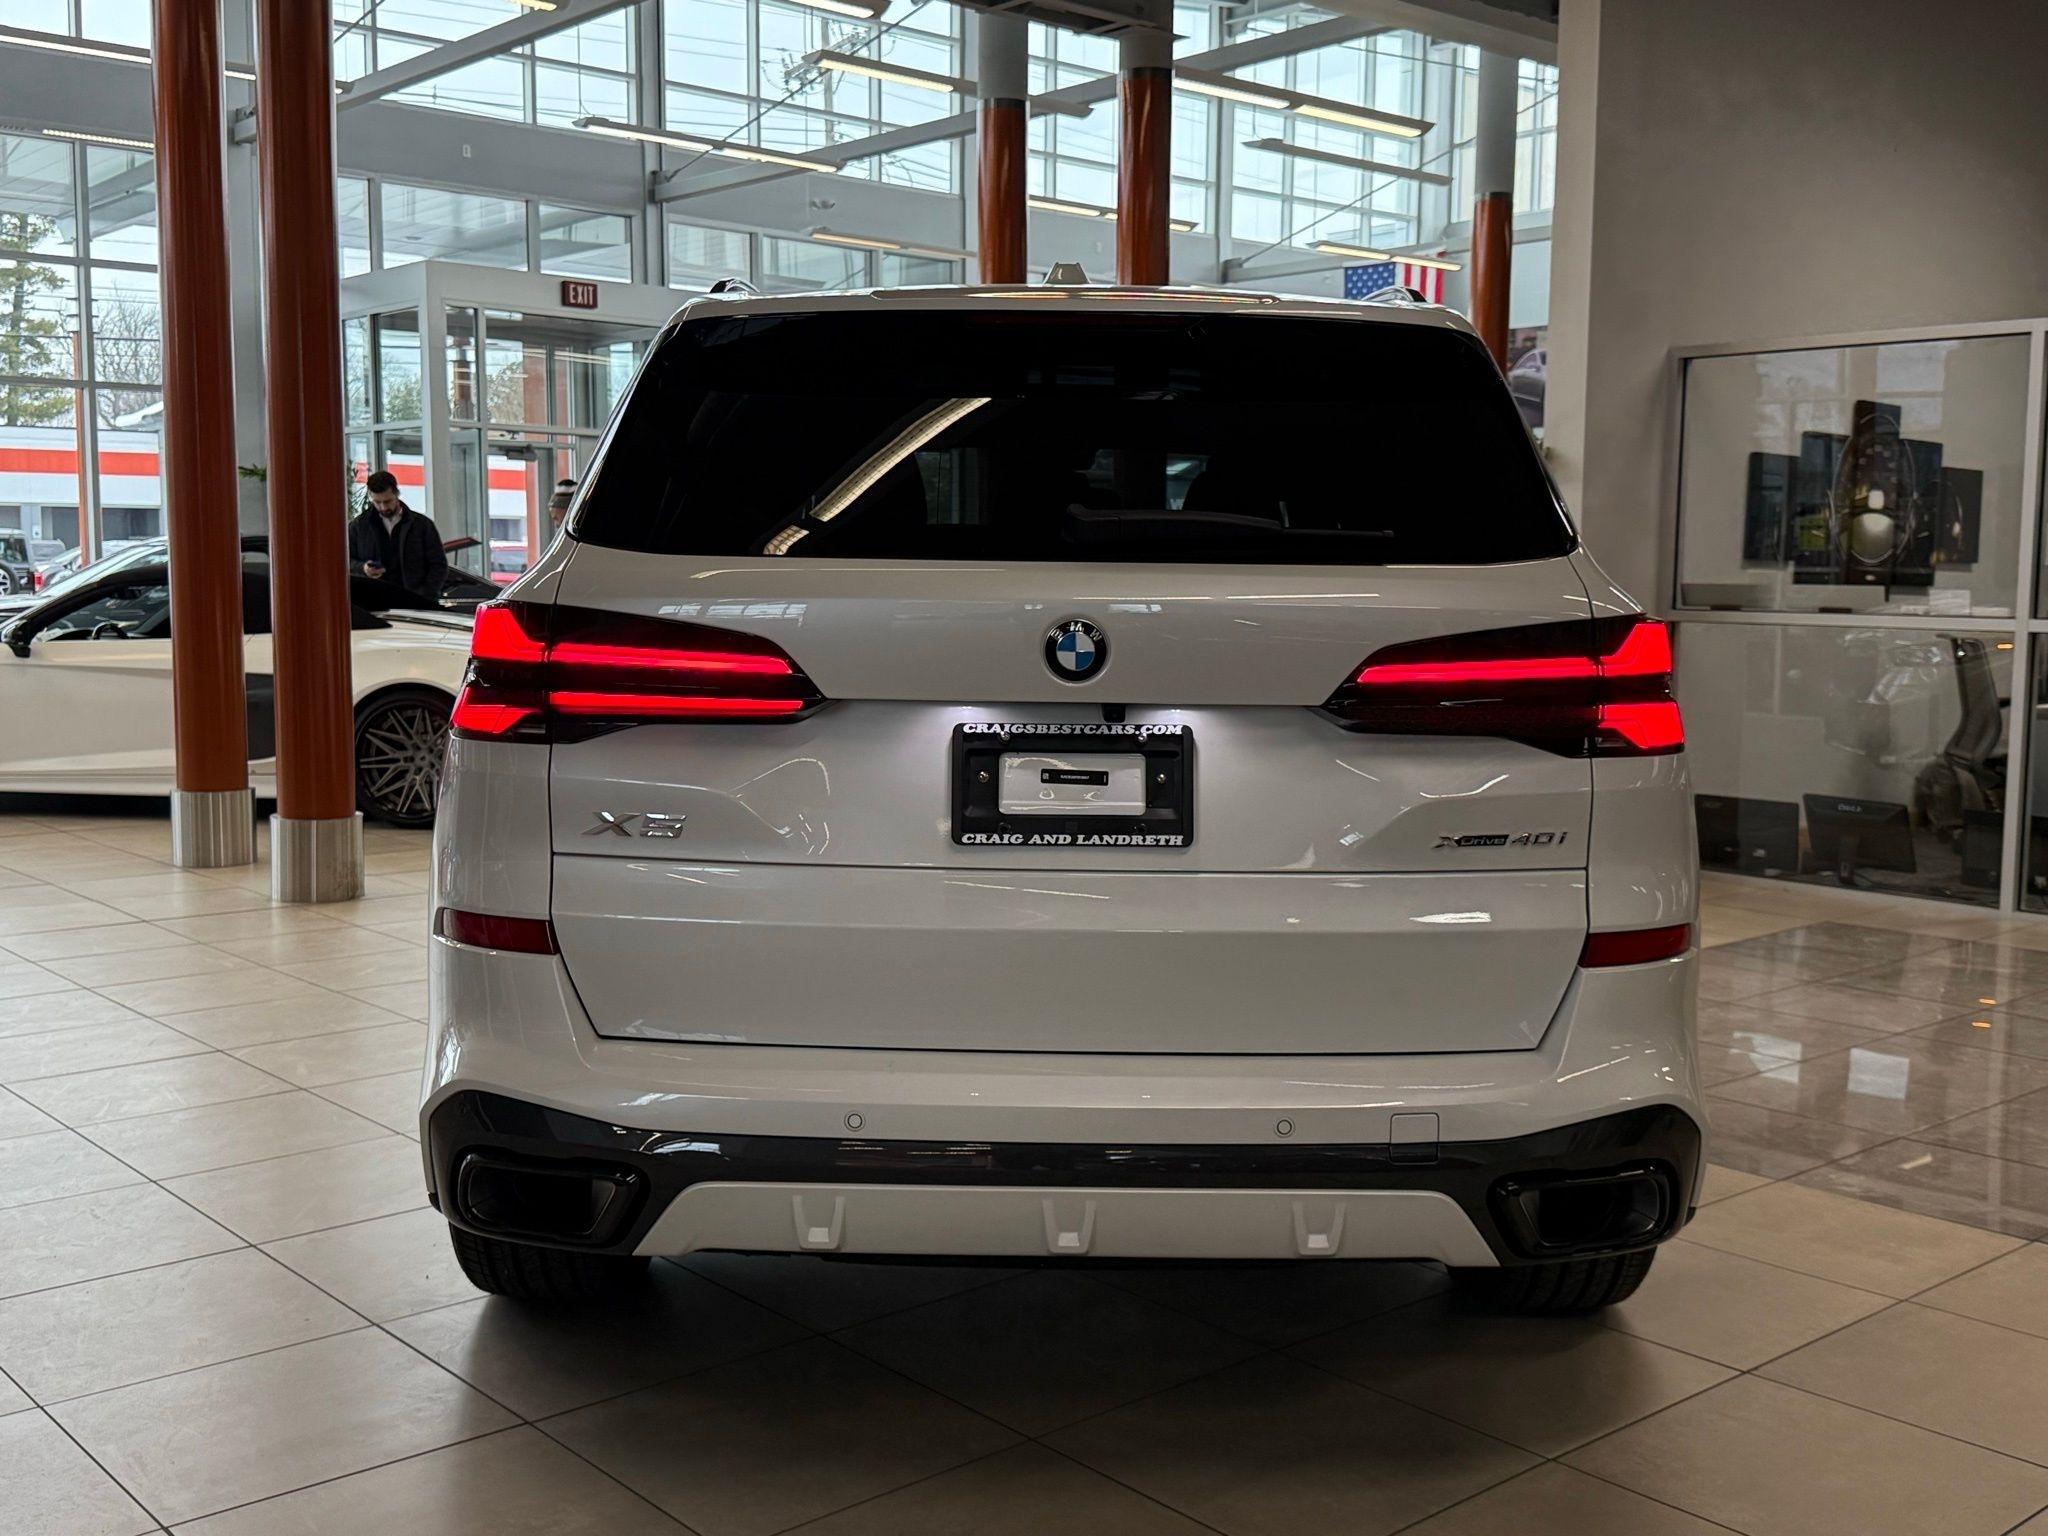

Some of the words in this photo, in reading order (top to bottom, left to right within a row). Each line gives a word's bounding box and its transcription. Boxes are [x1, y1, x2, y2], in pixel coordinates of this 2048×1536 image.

[570, 284, 594, 305] EXIT
[963, 724, 1183, 735] CRAIGSBESTCARS.COM
[581, 811, 687, 838] X5
[961, 834, 1024, 844] CRAIG
[1028, 834, 1072, 845] AND
[1076, 834, 1184, 846] LANDRETH
